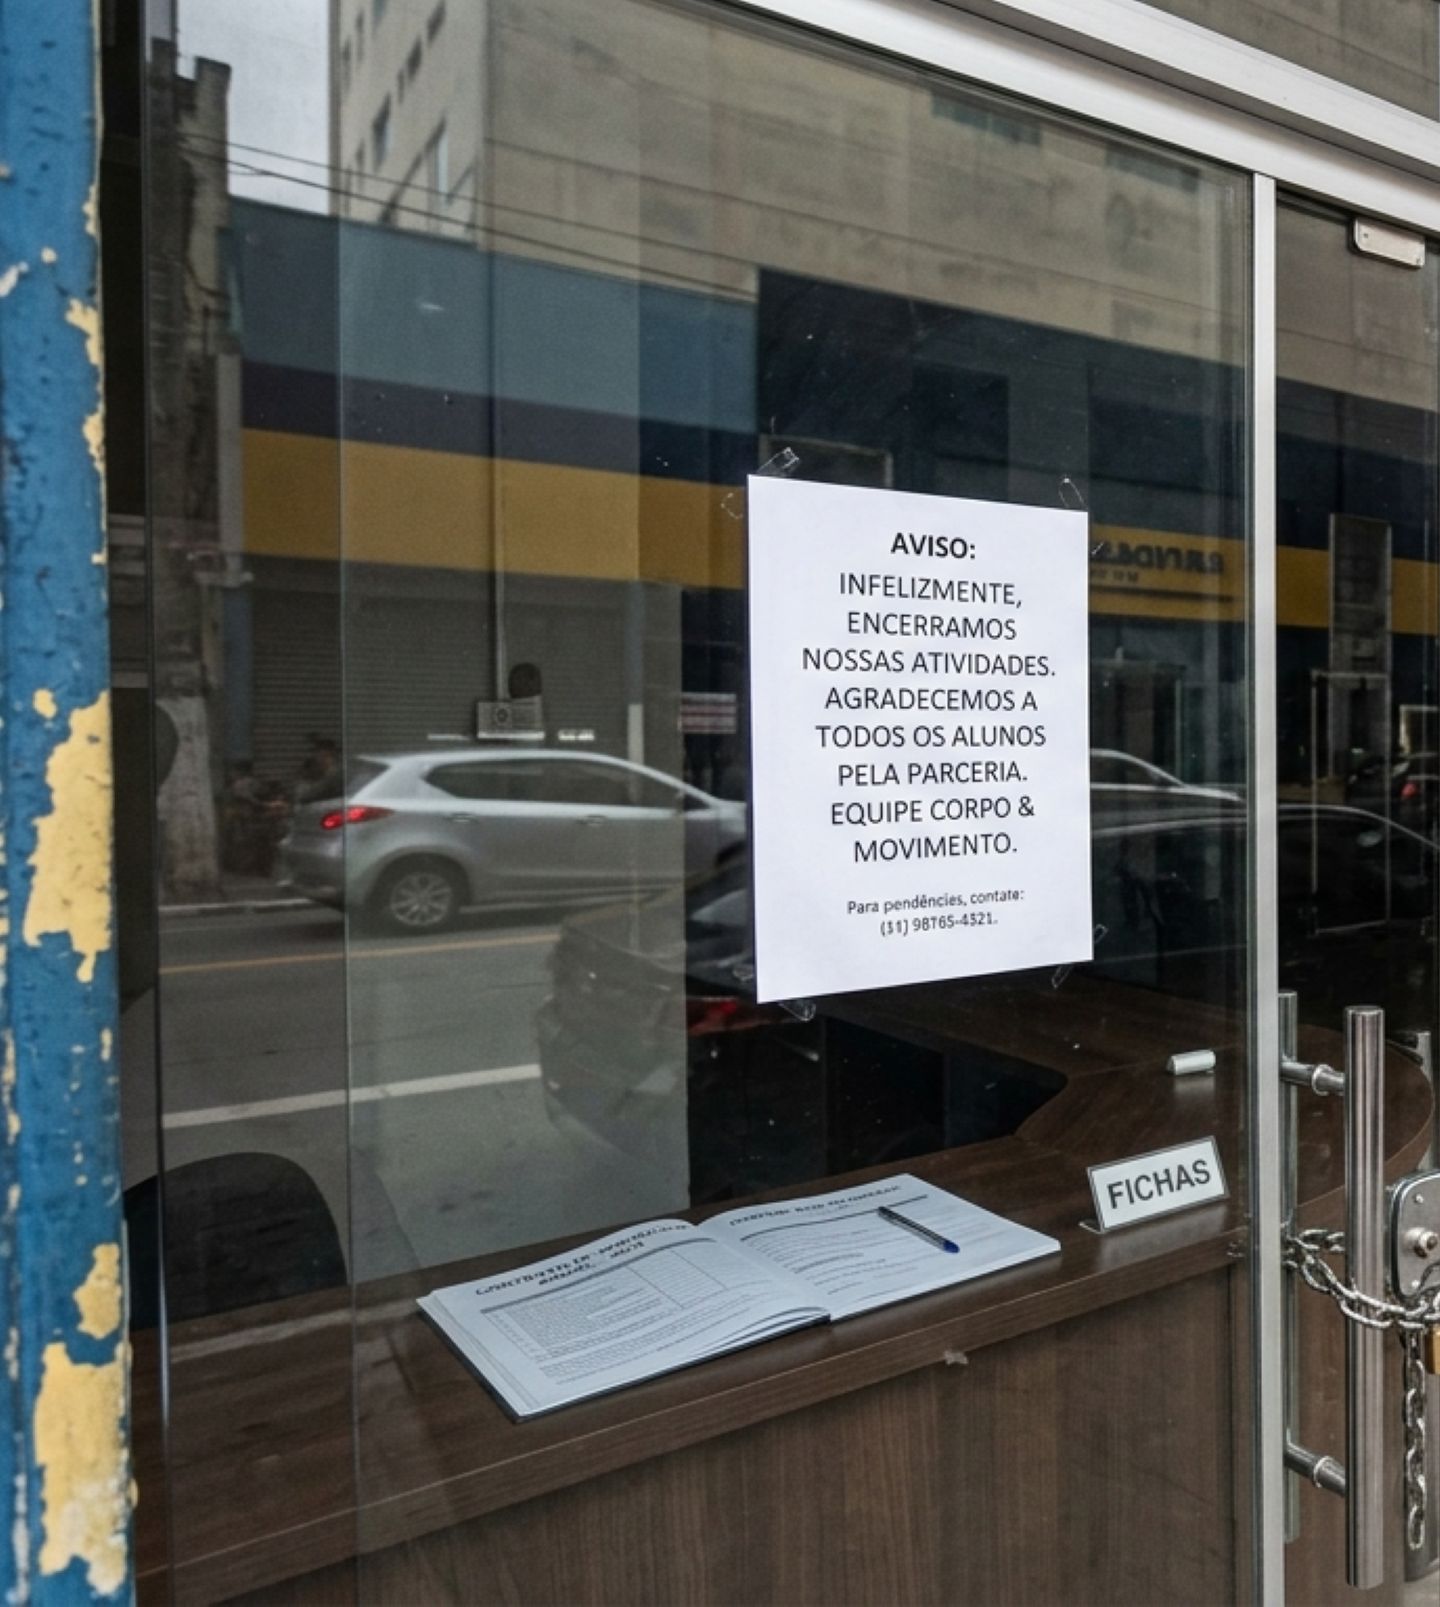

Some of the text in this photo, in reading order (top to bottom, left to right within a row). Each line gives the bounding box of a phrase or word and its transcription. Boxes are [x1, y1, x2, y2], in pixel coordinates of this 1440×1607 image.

[890, 532, 976, 560] AVISO:
[840, 572, 1022, 609] INFELIZMENTE,
[847, 611, 1017, 641] ENCERRAMOS
[802, 647, 1056, 677] NOSSAS ATIVIDADES.
[824, 686, 1039, 712] AGRADECEMOS A
[815, 724, 1047, 749] TODOS OS ALUNOS
[838, 760, 1028, 787] PELA PARCERIA.
[831, 795, 1035, 827] EQUIPE CORPO &
[854, 831, 1018, 863] MOVIMENTO.
[847, 900, 880, 915] Para
[1107, 1160, 1211, 1209] FICHAS
